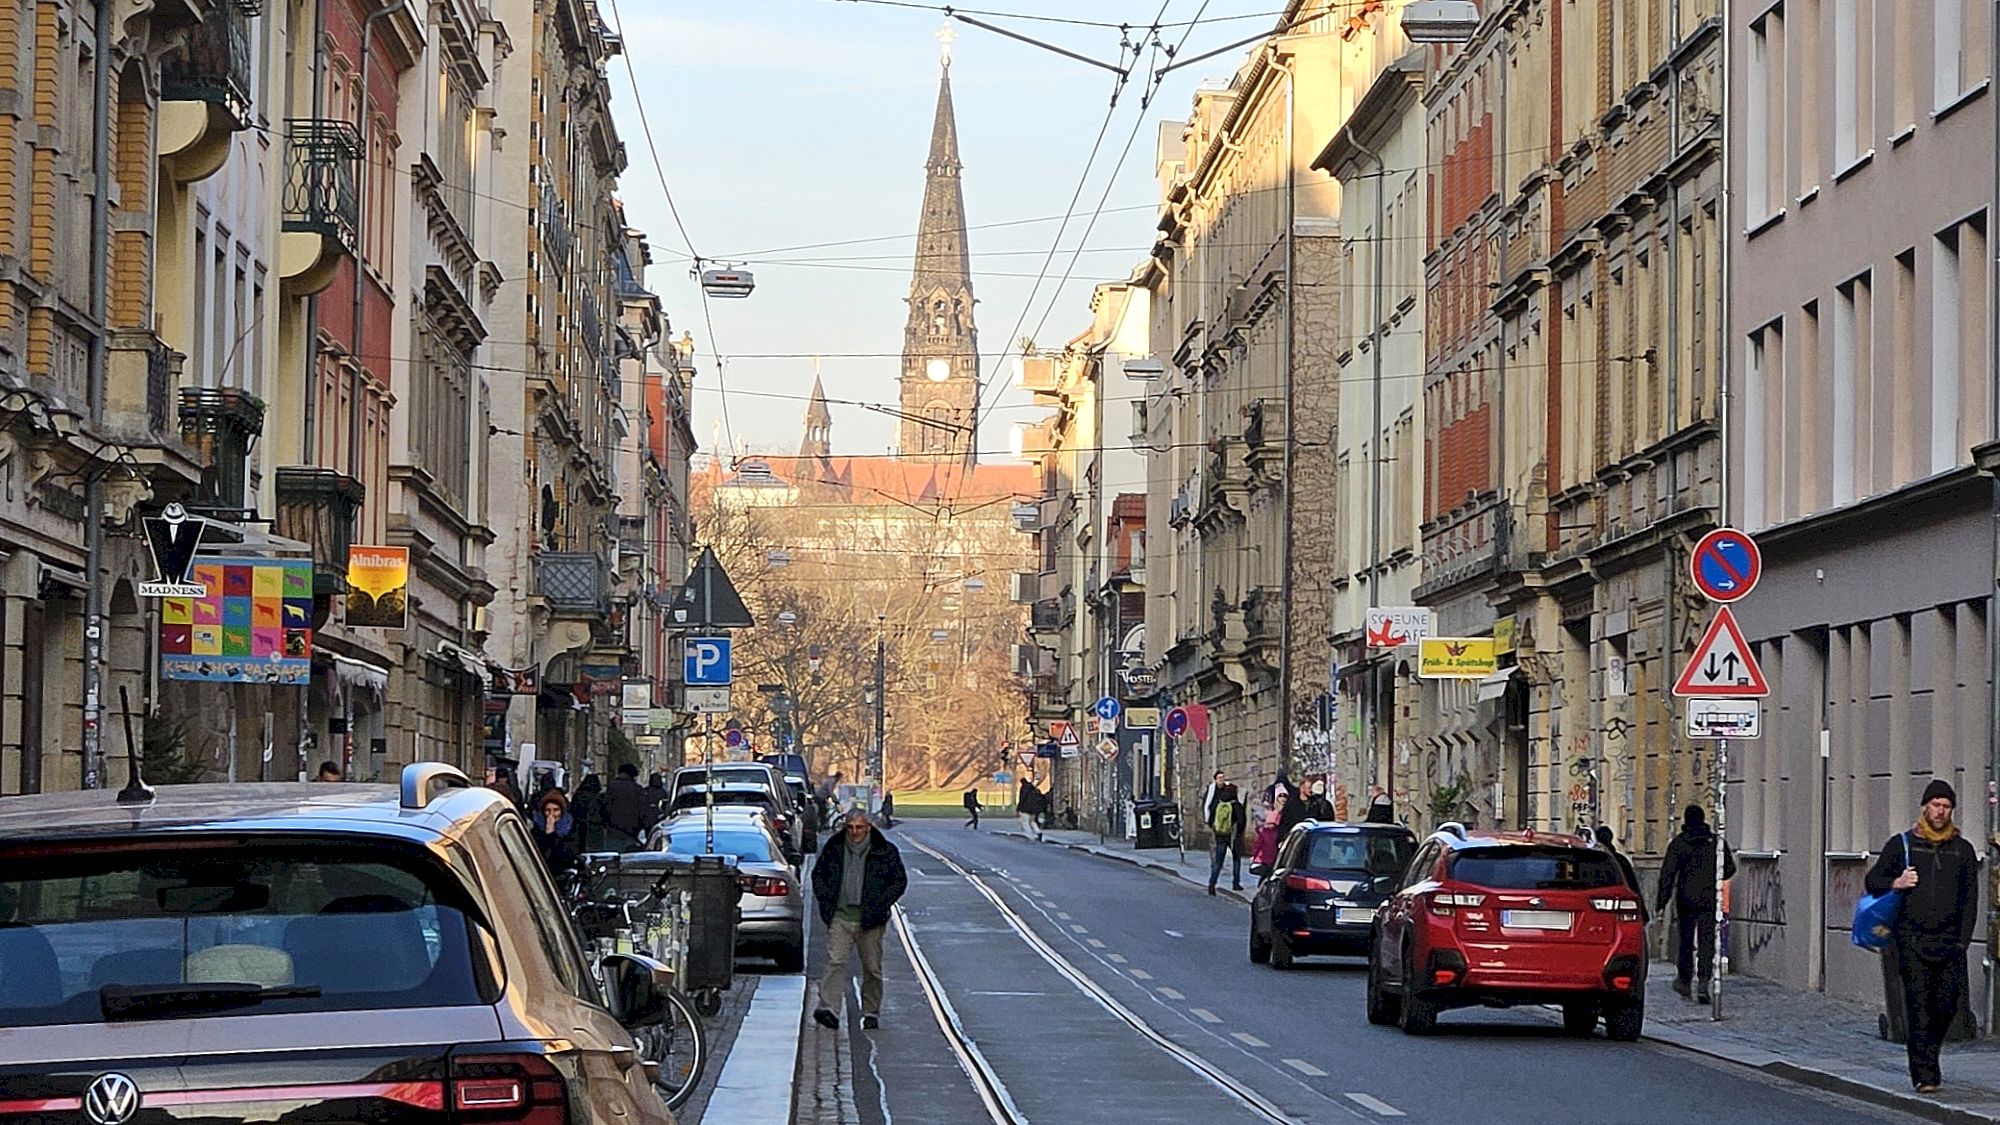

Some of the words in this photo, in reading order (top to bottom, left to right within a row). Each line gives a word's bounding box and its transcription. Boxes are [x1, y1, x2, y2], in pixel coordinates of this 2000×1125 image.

[141, 585, 205, 596] MADNESS
[695, 643, 721, 679] P
[244, 662, 310, 677] PASSAGE
